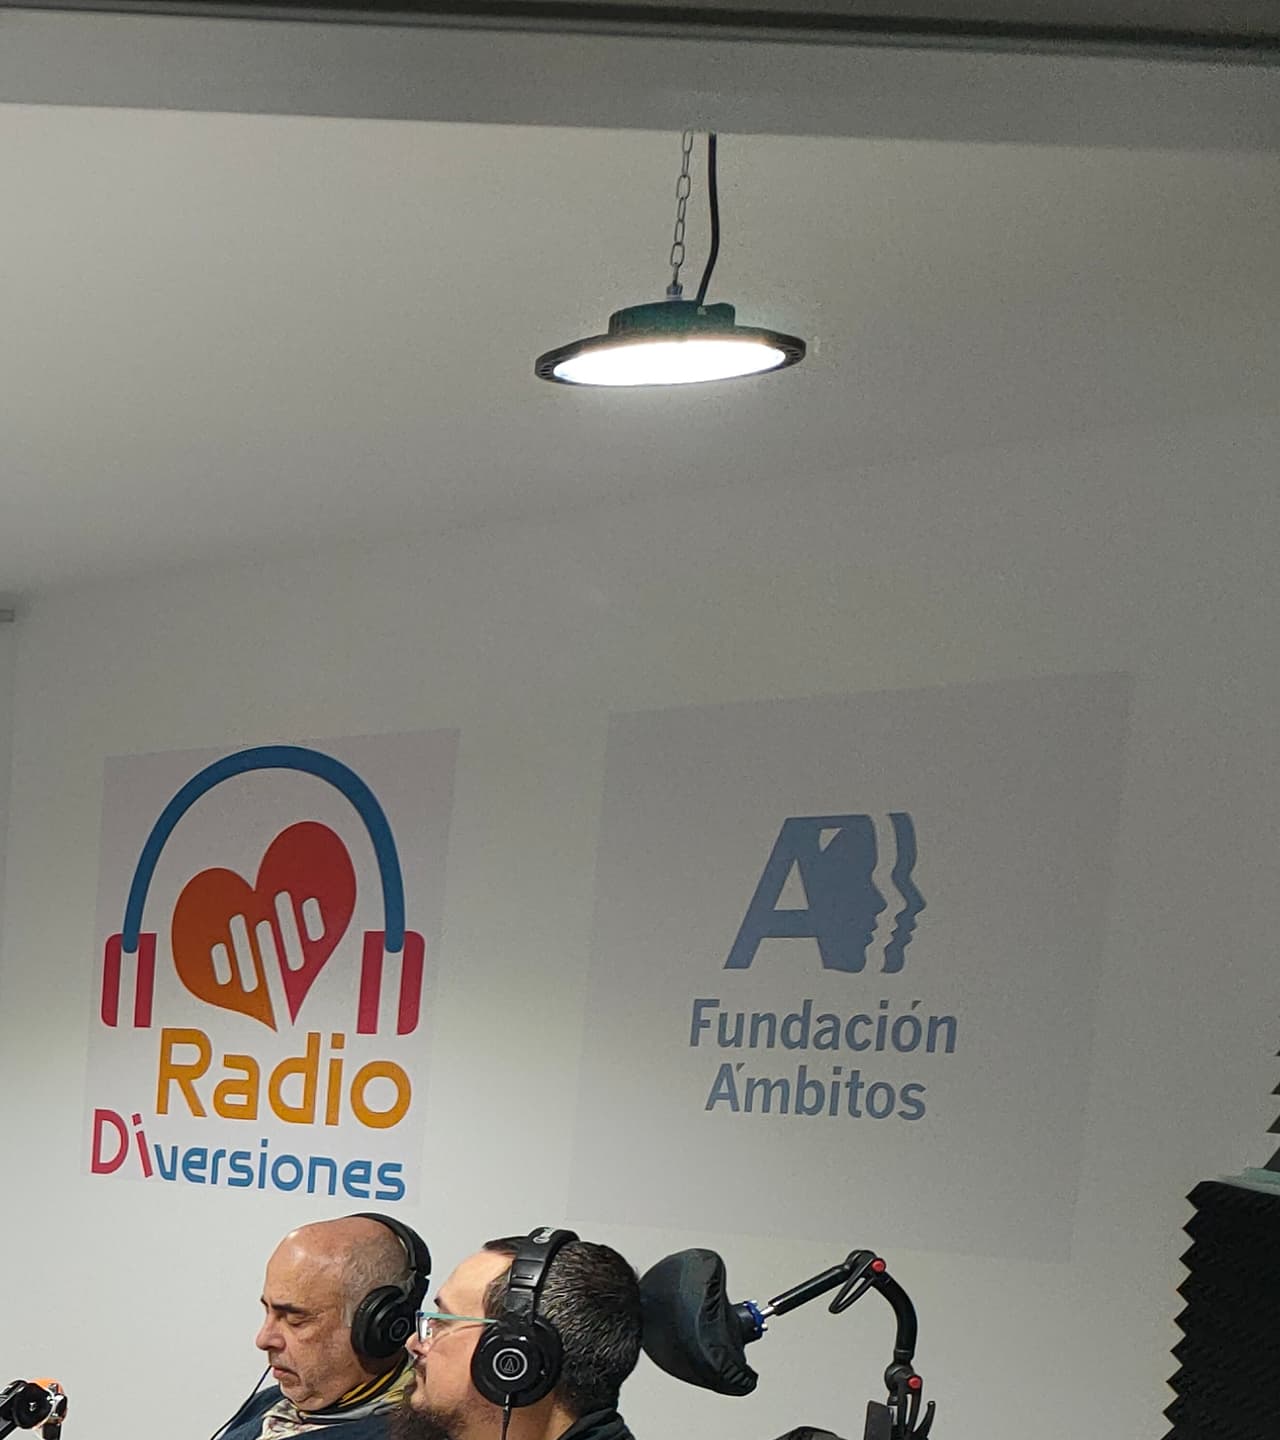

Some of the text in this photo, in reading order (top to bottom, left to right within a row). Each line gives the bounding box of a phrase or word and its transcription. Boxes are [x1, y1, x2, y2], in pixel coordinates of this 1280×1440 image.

[689, 998, 958, 1054] Fundación
[154, 1027, 412, 1130] Radio
[705, 1061, 927, 1121] Ámbitos
[90, 1108, 406, 1201] Diversiones
